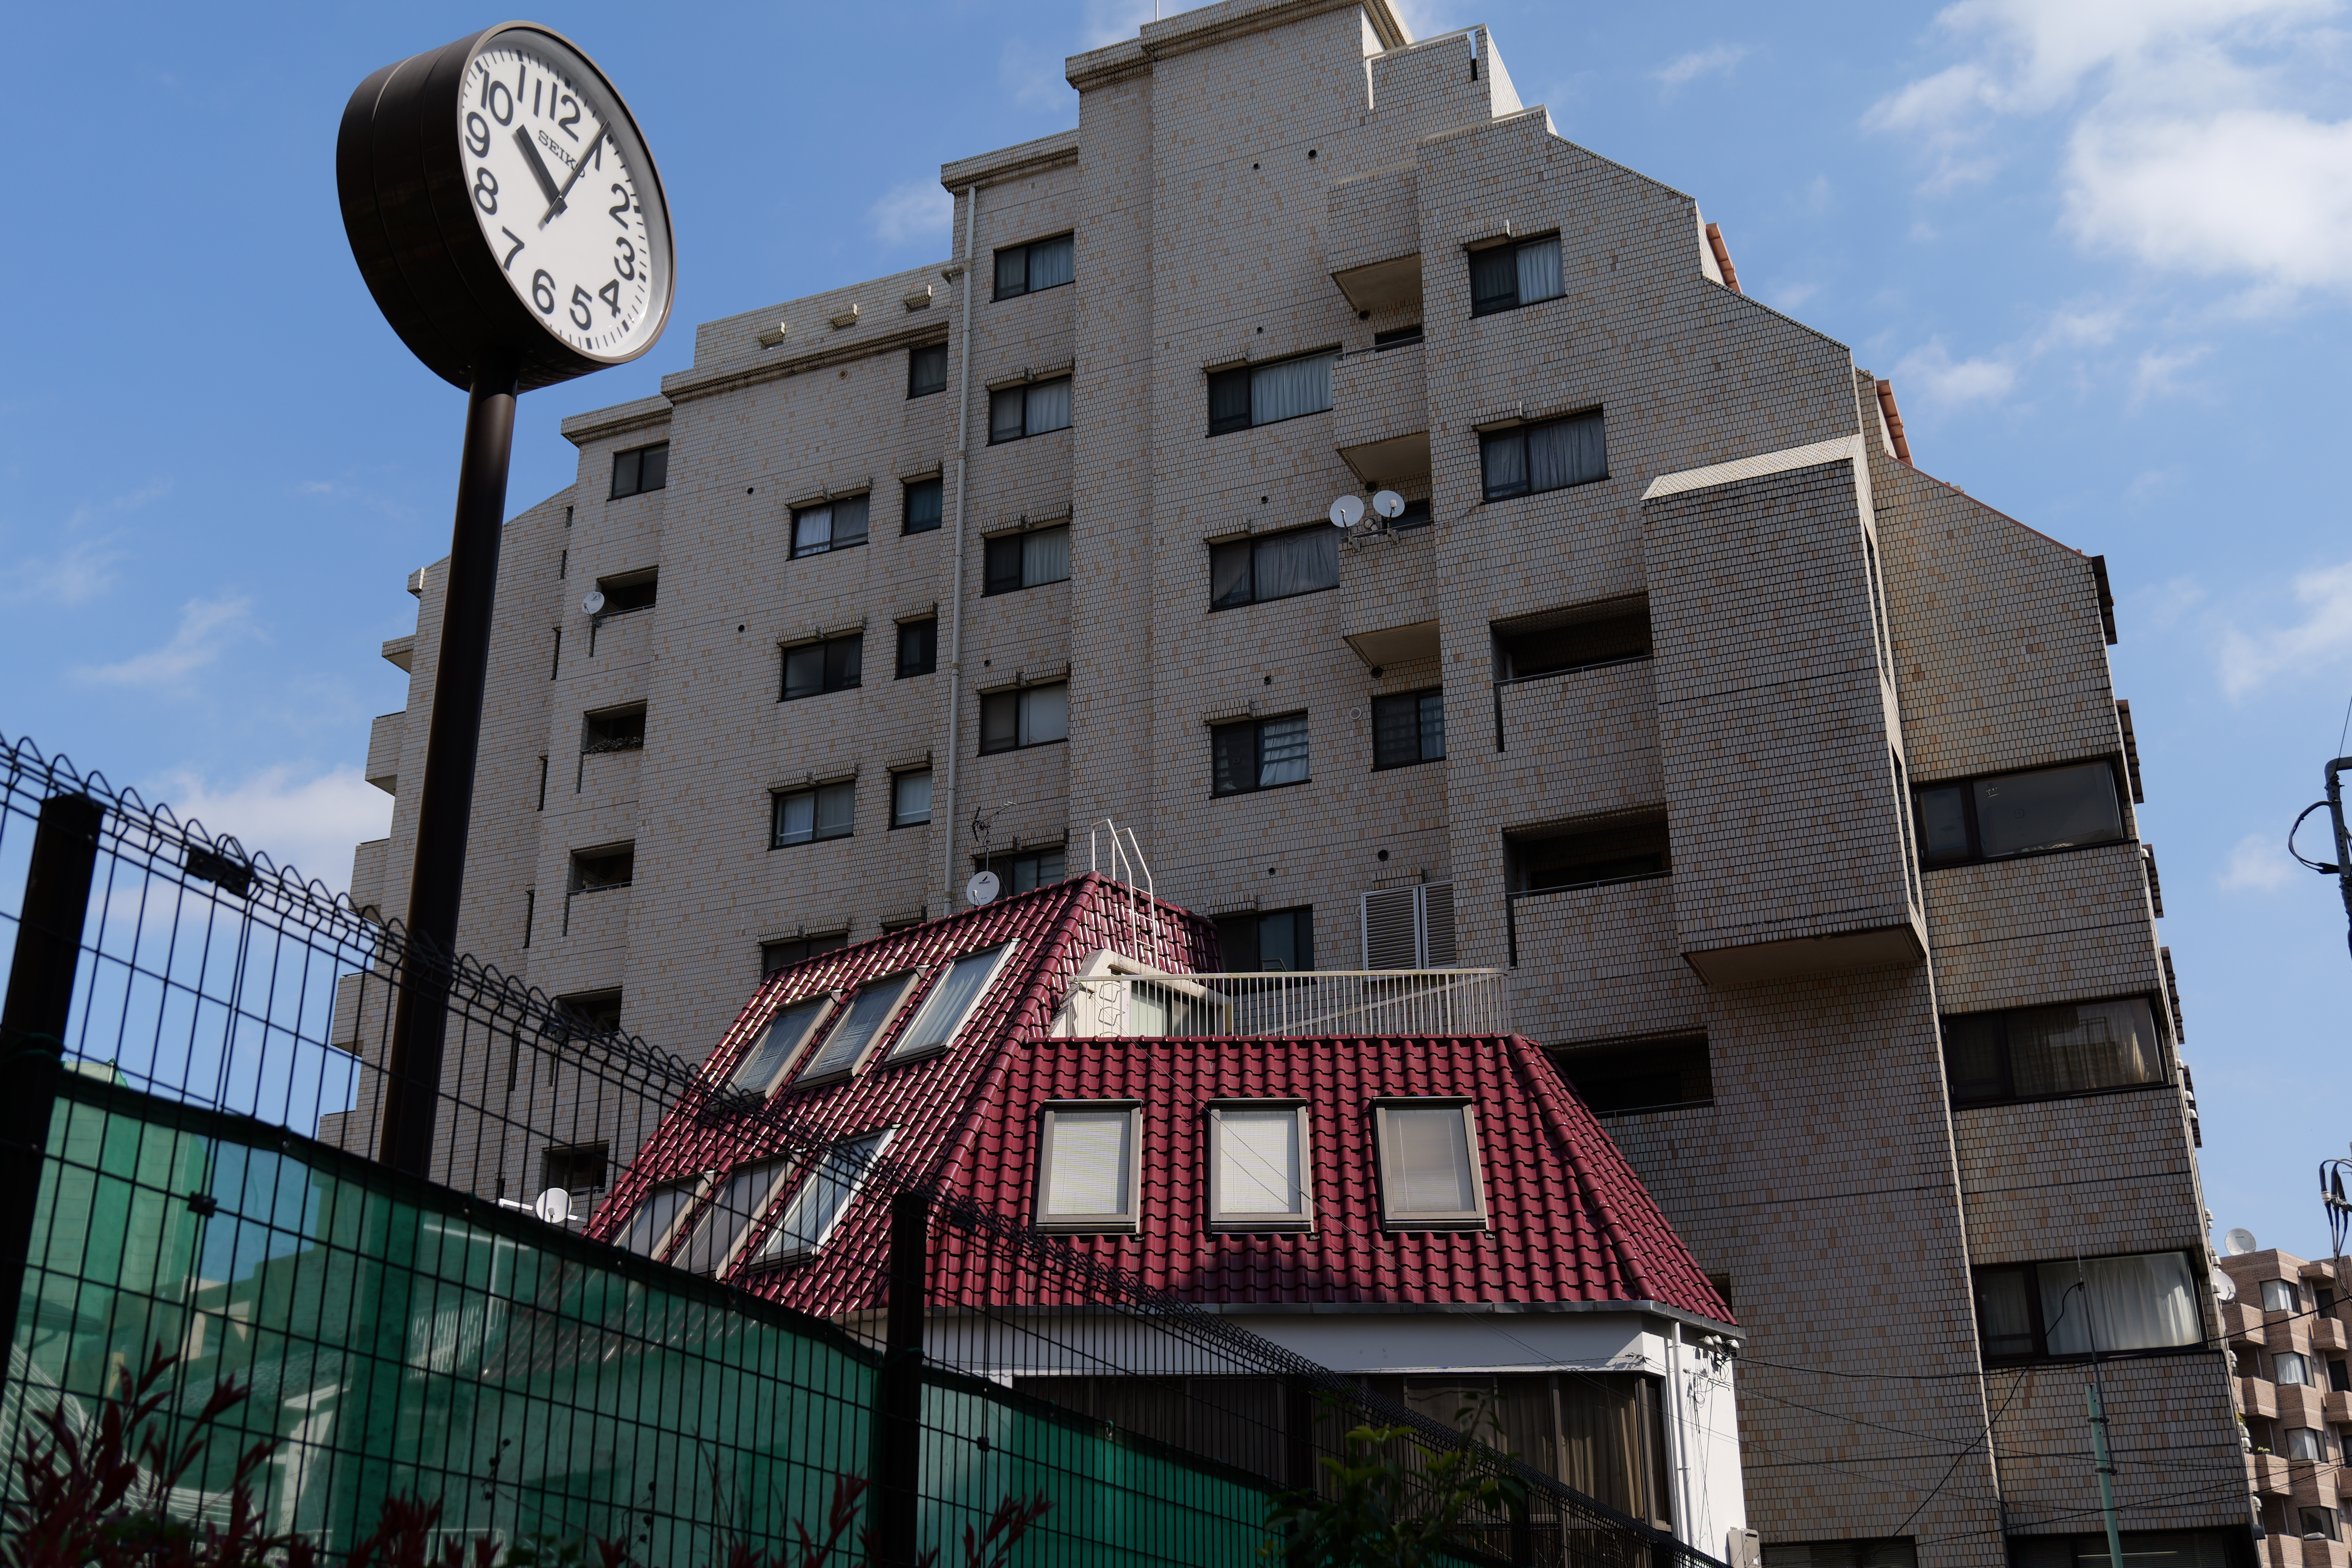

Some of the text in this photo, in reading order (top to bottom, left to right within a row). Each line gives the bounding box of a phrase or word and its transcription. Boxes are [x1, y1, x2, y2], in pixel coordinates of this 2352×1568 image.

[481, 69, 514, 126] 10
[517, 63, 542, 118] 11
[550, 82, 581, 142] 12
[465, 111, 490, 158] 9
[474, 167, 498, 215] 8
[609, 183, 630, 230] 2
[502, 226, 524, 271] 7
[614, 237, 635, 281] 3
[532, 269, 555, 314] 6
[570, 284, 592, 330] 5
[599, 279, 621, 318] 4
